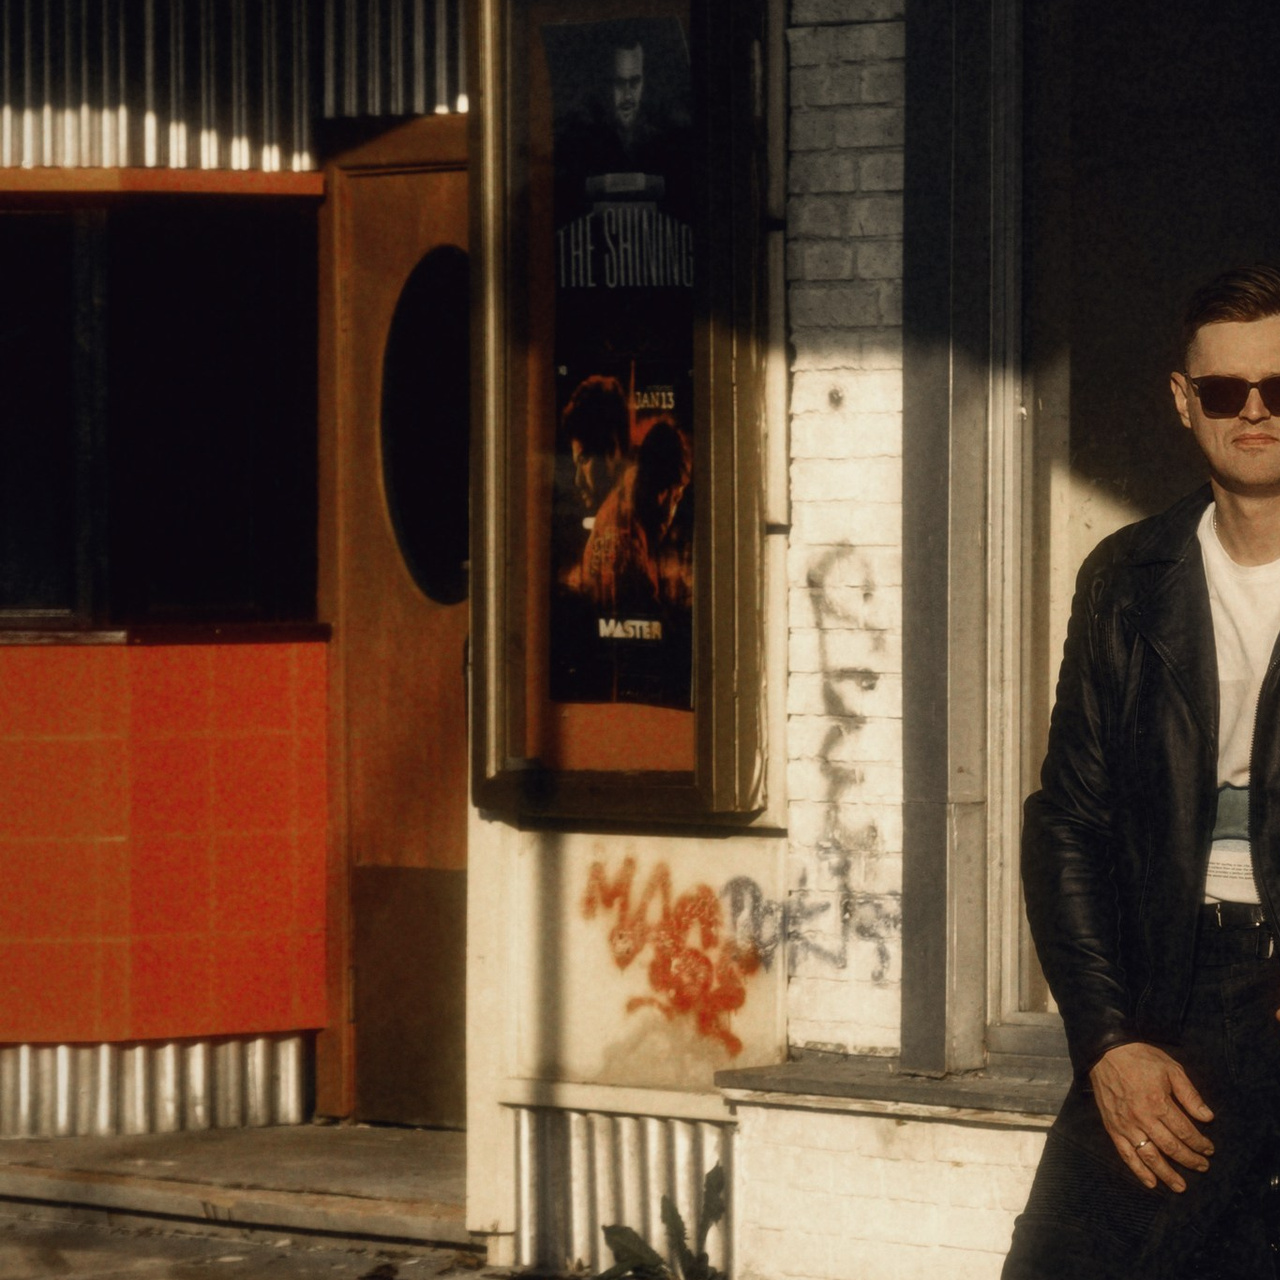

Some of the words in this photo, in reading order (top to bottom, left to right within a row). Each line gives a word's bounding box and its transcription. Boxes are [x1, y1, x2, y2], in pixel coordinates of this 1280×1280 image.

[557, 214, 597, 288] THE
[603, 206, 694, 289] SHINING
[599, 618, 662, 639] MASTER
